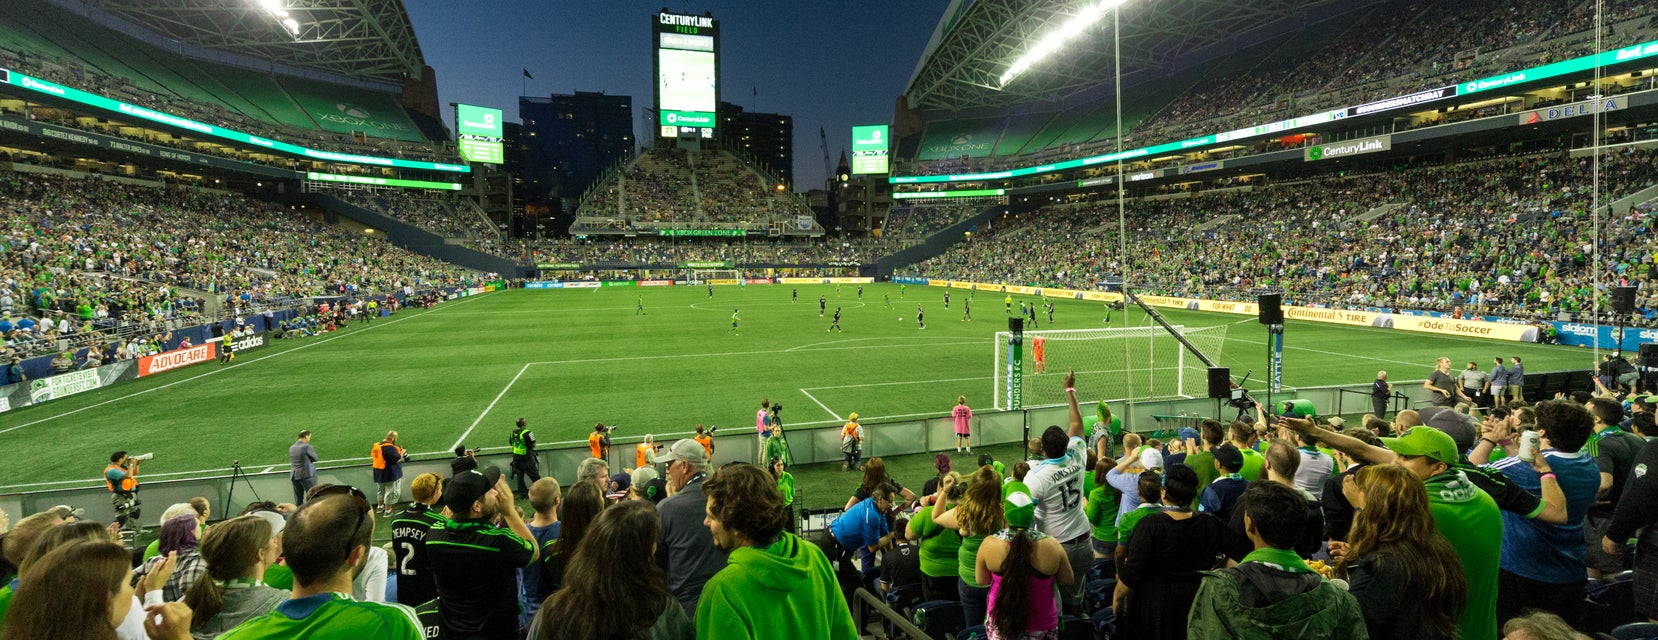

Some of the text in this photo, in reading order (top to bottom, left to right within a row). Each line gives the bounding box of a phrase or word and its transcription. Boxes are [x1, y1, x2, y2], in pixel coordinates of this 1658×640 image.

[660, 12, 712, 28] CENTURYLINK
[676, 26, 698, 34] FIELD
[1478, 72, 1526, 89] CenturyLink
[1548, 98, 1618, 120] DELTA
[1323, 138, 1383, 158] CenturyLink
[1131, 172, 1154, 182] verizon
[1288, 307, 1368, 322] Continental TIRE
[1418, 320, 1492, 335] #OdeToSoccer
[1562, 323, 1597, 334] slalom
[1640, 329, 1658, 339] sla
[238, 335, 264, 350] adidas
[150, 346, 207, 372] ADVOCARE
[1014, 360, 1021, 370] FC
[1058, 476, 1080, 512] 15
[1440, 486, 1476, 501] adid
[400, 542, 416, 576] 2
[426, 626, 440, 638] ED
